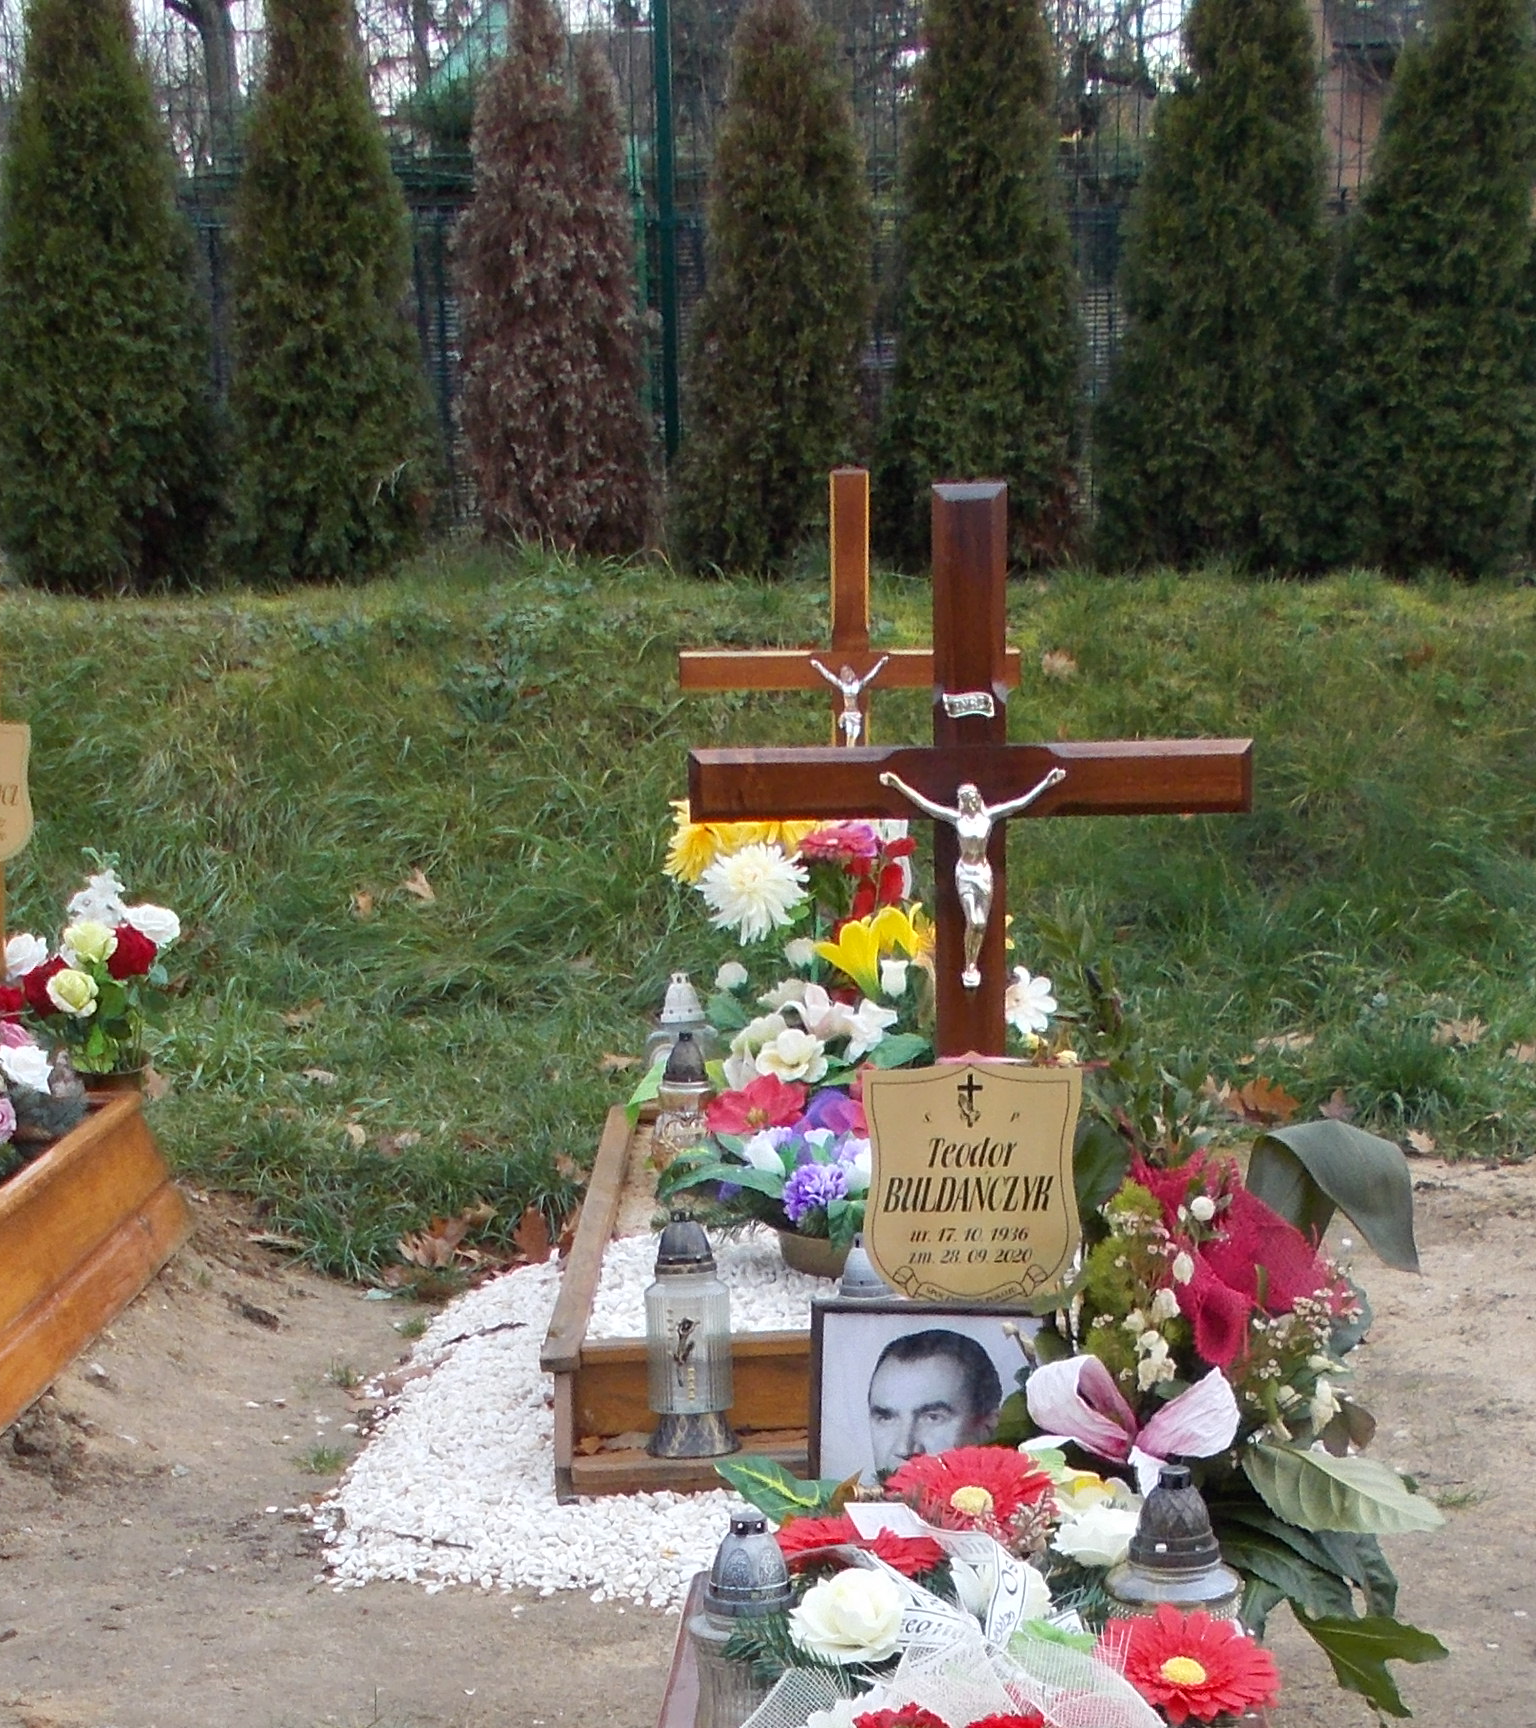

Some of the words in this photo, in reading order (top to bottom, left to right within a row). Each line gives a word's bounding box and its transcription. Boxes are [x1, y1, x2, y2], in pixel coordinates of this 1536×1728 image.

[928, 1137, 1017, 1168] Teodor
[883, 1171, 1054, 1213] BULDAŃCZYK
[991, 1226, 1029, 1241] 1936
[993, 1247, 1033, 1264] 2020
